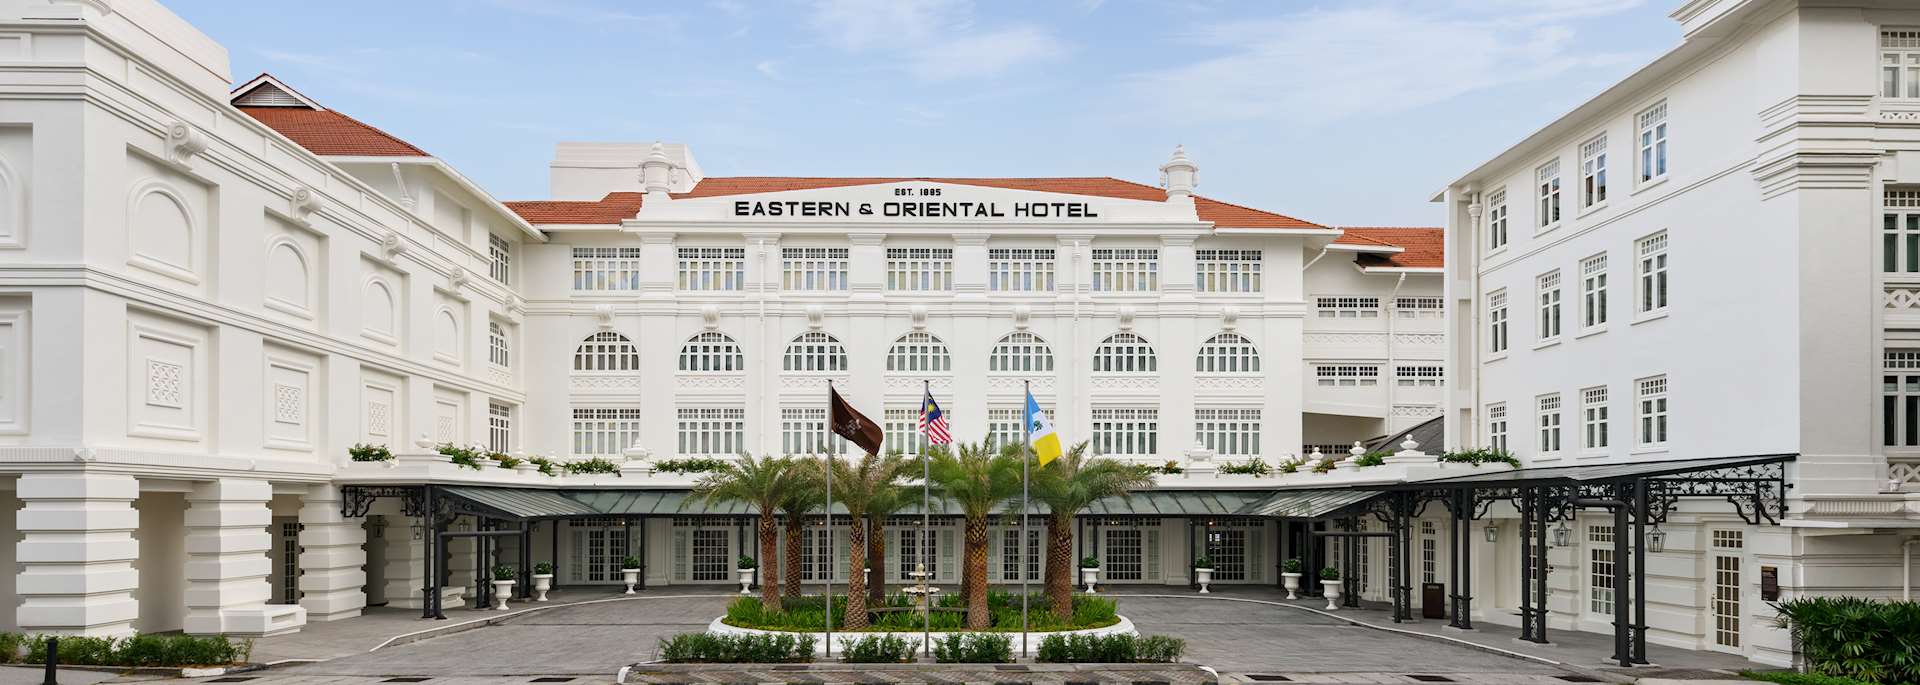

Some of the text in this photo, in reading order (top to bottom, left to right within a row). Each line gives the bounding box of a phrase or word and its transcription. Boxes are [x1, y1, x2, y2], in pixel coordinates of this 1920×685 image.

[895, 188, 942, 196] EST. 1885
[735, 201, 1098, 217] EASTERN & ORIENTAL HOTEL
